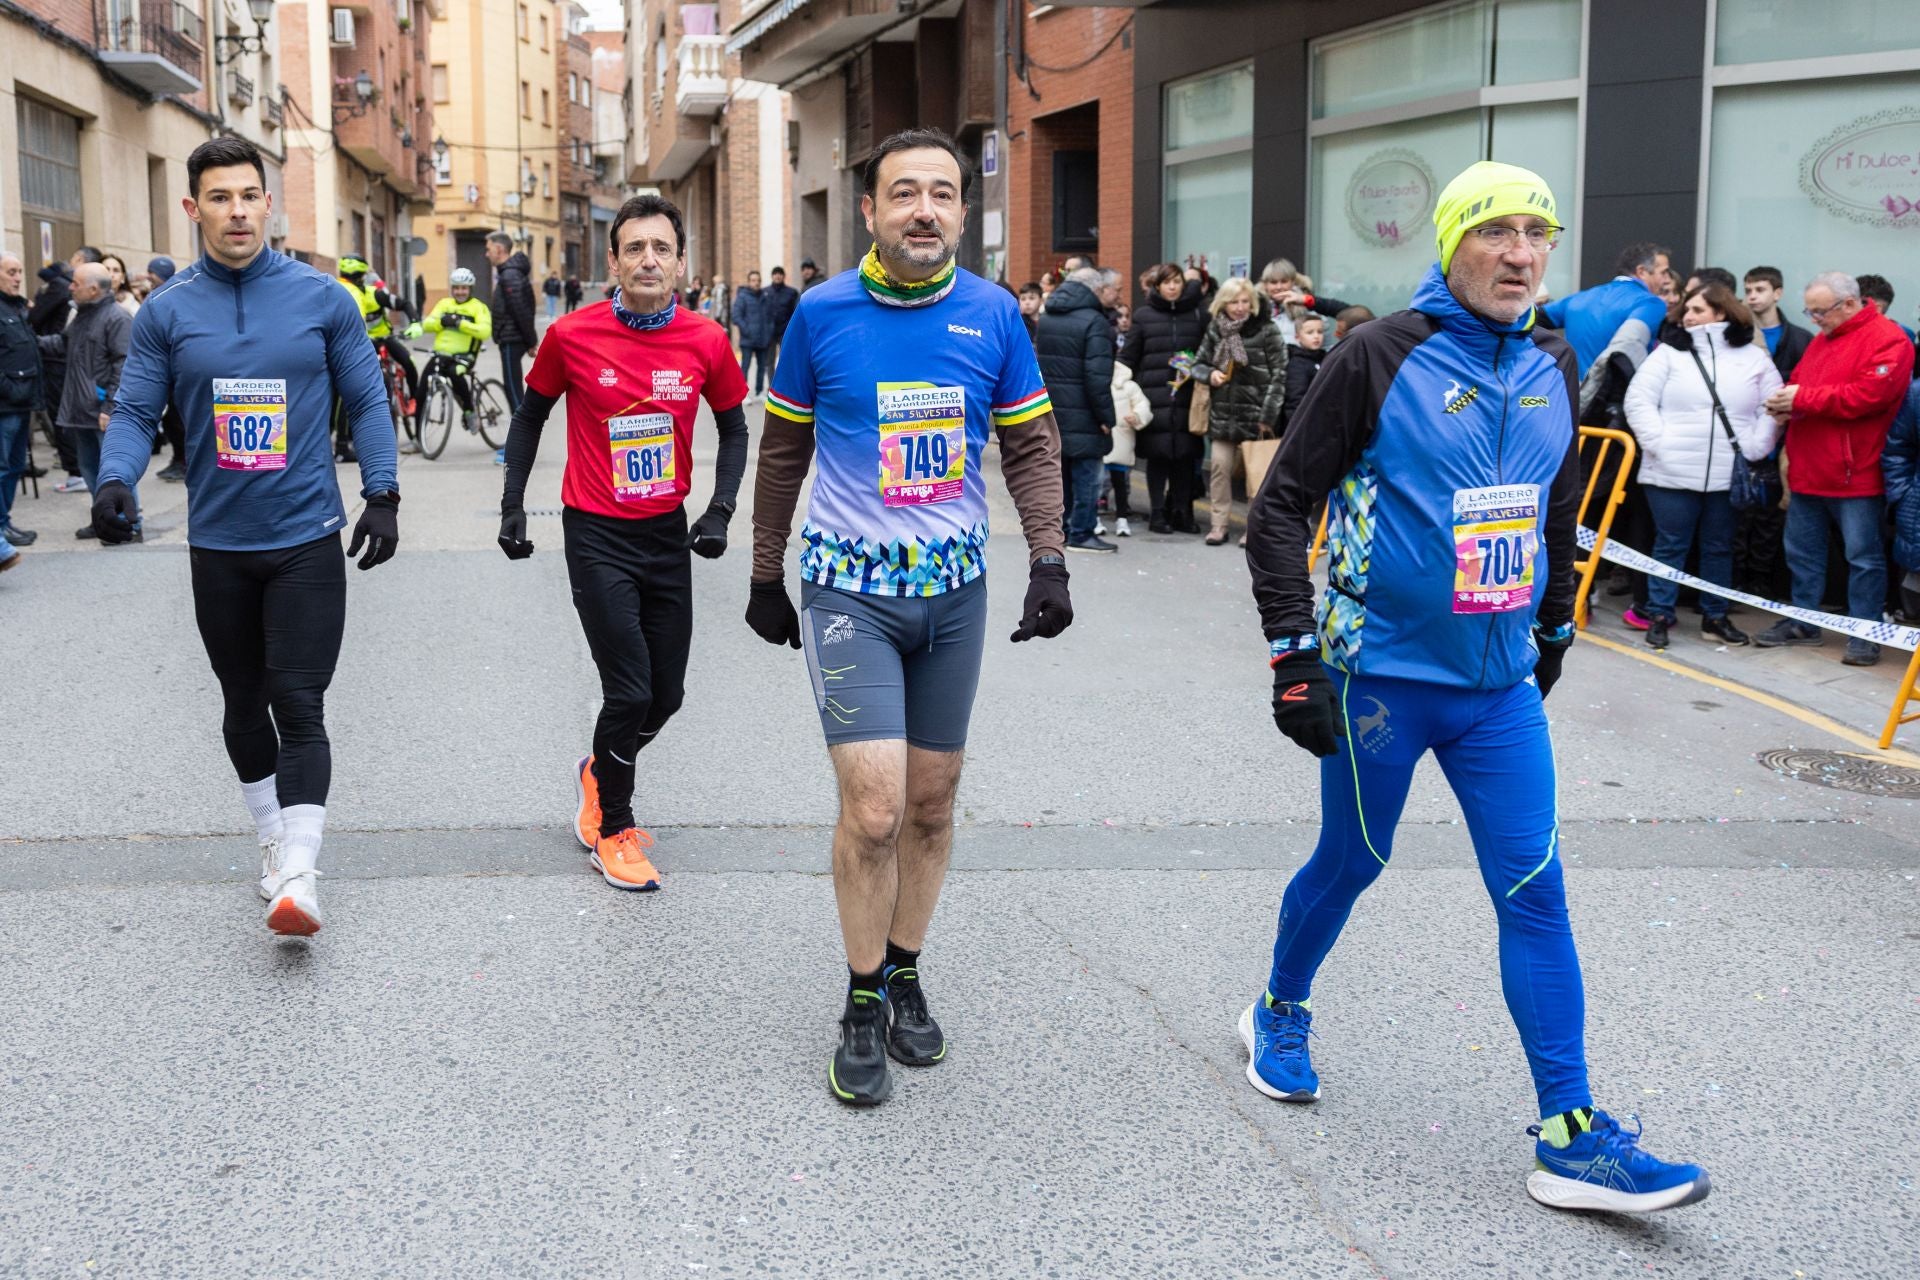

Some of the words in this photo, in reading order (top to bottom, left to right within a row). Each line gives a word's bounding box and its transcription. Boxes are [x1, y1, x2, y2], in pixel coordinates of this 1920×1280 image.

[651, 370, 682, 378] CARRERA
[652, 377, 680, 385] CAMPUS
[652, 385, 693, 393] UNIVERSIDAD
[238, 395, 282, 403] SILVESTRE
[652, 393, 661, 401] DE
[662, 393, 671, 401] LA
[671, 393, 688, 401] RIOJA
[892, 391, 959, 402] LARDERO
[890, 398, 962, 409] ayuntamiento
[886, 411, 904, 420] SAN
[909, 408, 961, 418] SILVESTRE
[618, 420, 671, 430] ayuntamiento
[619, 415, 669, 426] LARDERO
[880, 424, 897, 432] XVIII
[920, 420, 944, 429] Popular
[228, 415, 272, 452] 682
[632, 427, 670, 437] SILVESTRE
[230, 454, 257, 465] PEVISA
[899, 433, 949, 481] 749
[626, 446, 663, 483] 681
[627, 484, 653, 495] PEVISA
[900, 485, 934, 498] PEVISA
[1468, 489, 1533, 502] LARDERO
[1466, 497, 1536, 508] ayuntamiento
[1461, 511, 1482, 521] SAN
[1477, 536, 1524, 586] 704
[1473, 591, 1510, 605] PEVISA
